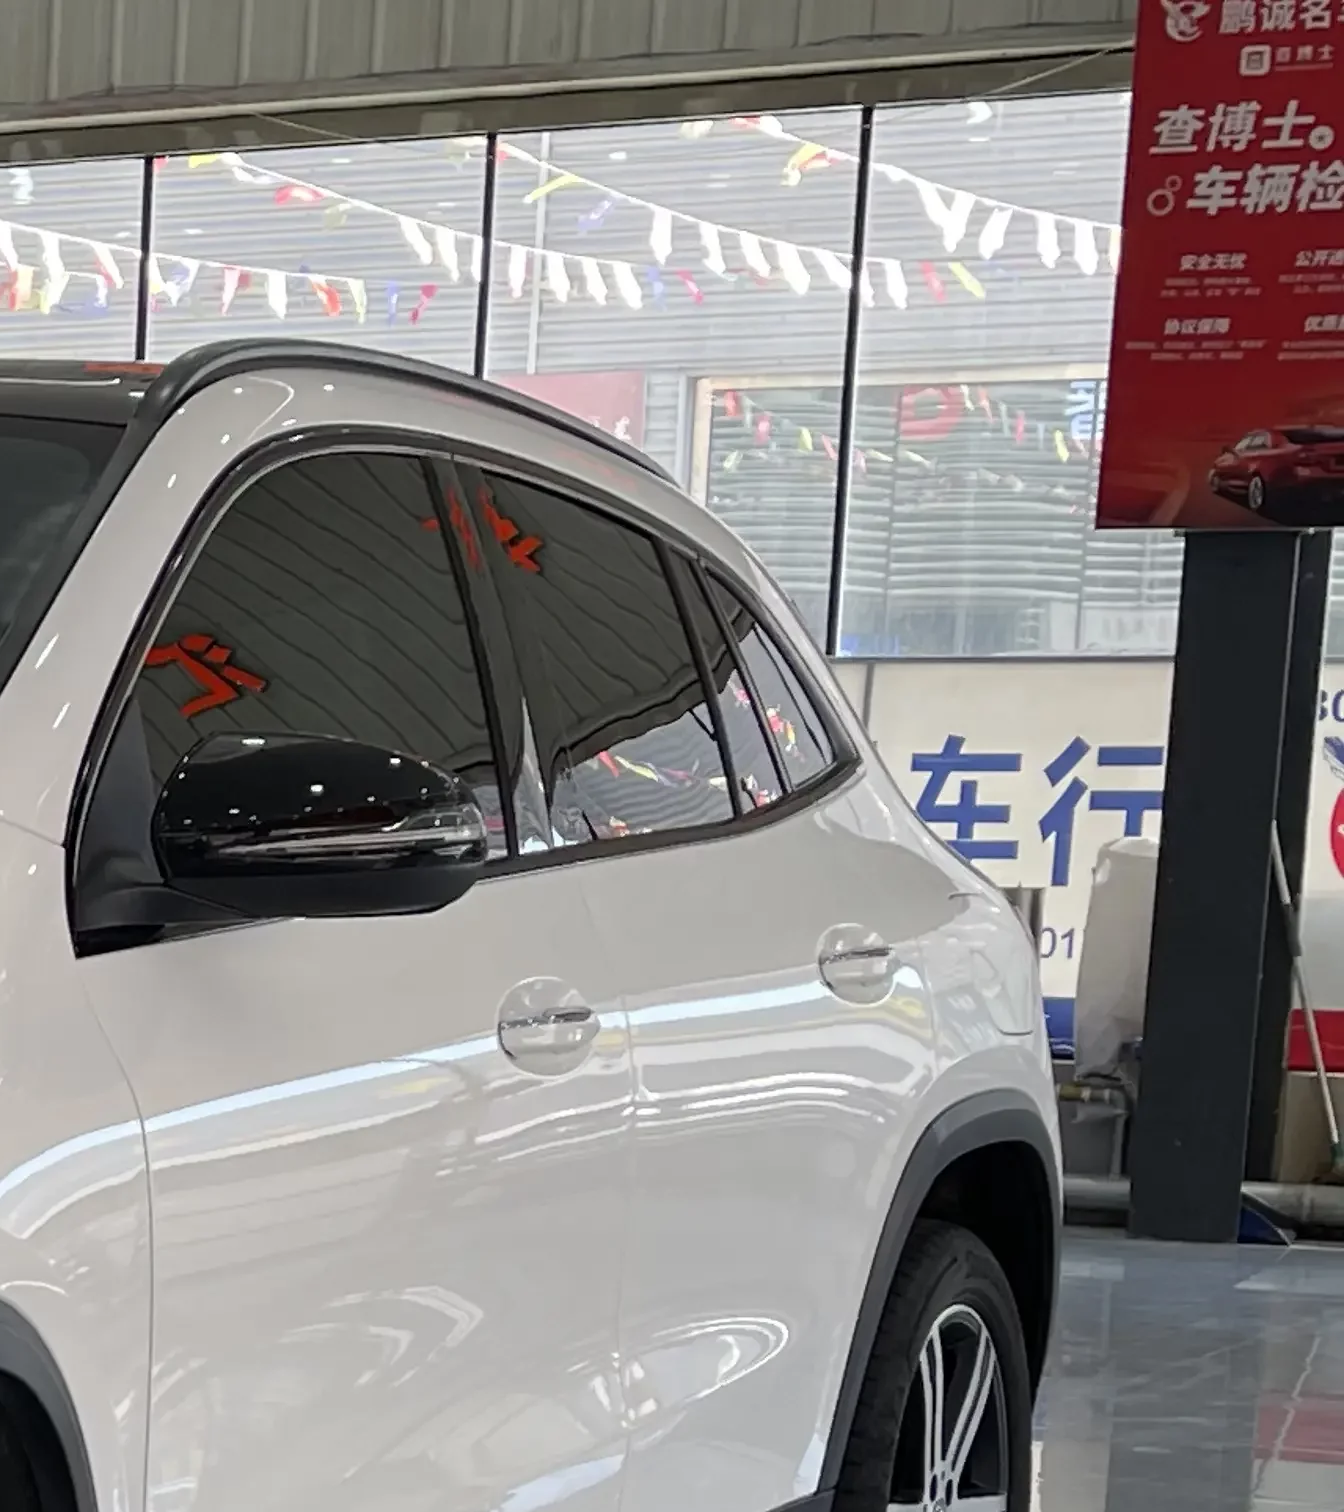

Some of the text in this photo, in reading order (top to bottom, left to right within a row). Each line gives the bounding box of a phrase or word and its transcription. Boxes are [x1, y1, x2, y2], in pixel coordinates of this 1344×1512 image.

[1219, 0, 1344, 34] 鹏诚名
[1149, 99, 1316, 155] 查博士
[1186, 160, 1344, 216] 车辆检
[912, 734, 1165, 887] 车行
